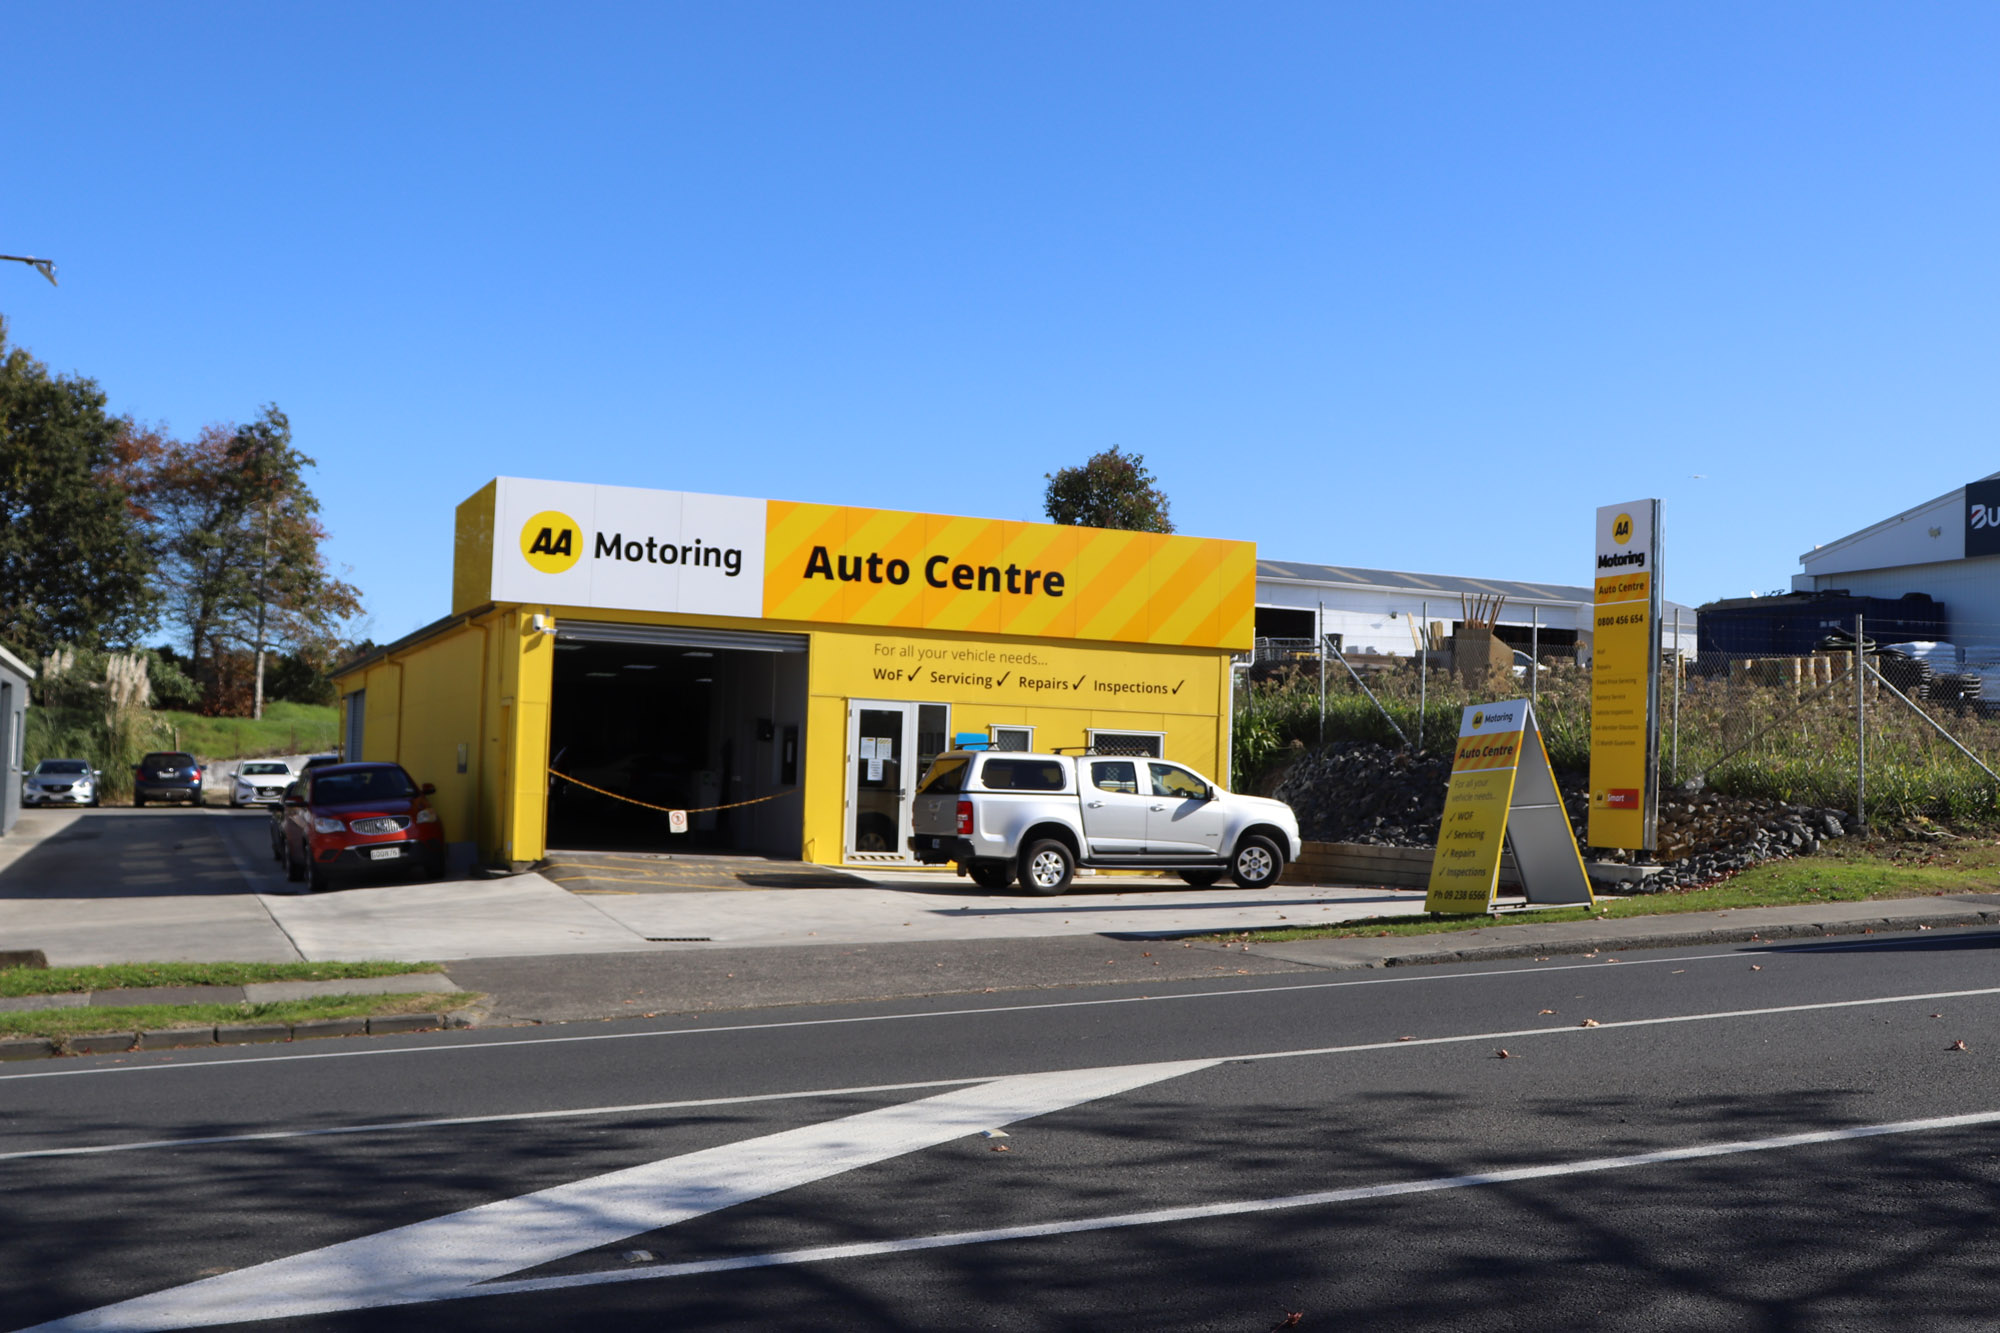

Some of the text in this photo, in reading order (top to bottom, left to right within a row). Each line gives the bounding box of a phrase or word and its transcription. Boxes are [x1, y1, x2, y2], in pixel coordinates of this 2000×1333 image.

[1615, 521, 1628, 536] AA
[528, 527, 742, 577] AA Motoring
[1598, 550, 1645, 568] Motoring
[803, 546, 1065, 597] Auto Centre
[1598, 582, 1644, 595] Auto Centre
[1598, 614, 1644, 627] 0800 456 654
[874, 643, 1048, 666] For all your vehicle needs...
[873, 668, 1168, 695] WoF Servicing Repairs Inspections
[1474, 712, 1513, 724] AA Motoring
[1459, 745, 1513, 759] Auto Centre
[1454, 779, 1488, 790] For all your
[1452, 792, 1473, 802] vehicle
[1453, 830, 1486, 840] Servicing
[1450, 848, 1476, 859] Repairs
[1446, 867, 1486, 878] Inspections
[1433, 890, 1443, 899] Ph
[1444, 890, 1453, 899] 09
[1454, 890, 1467, 900] 238
